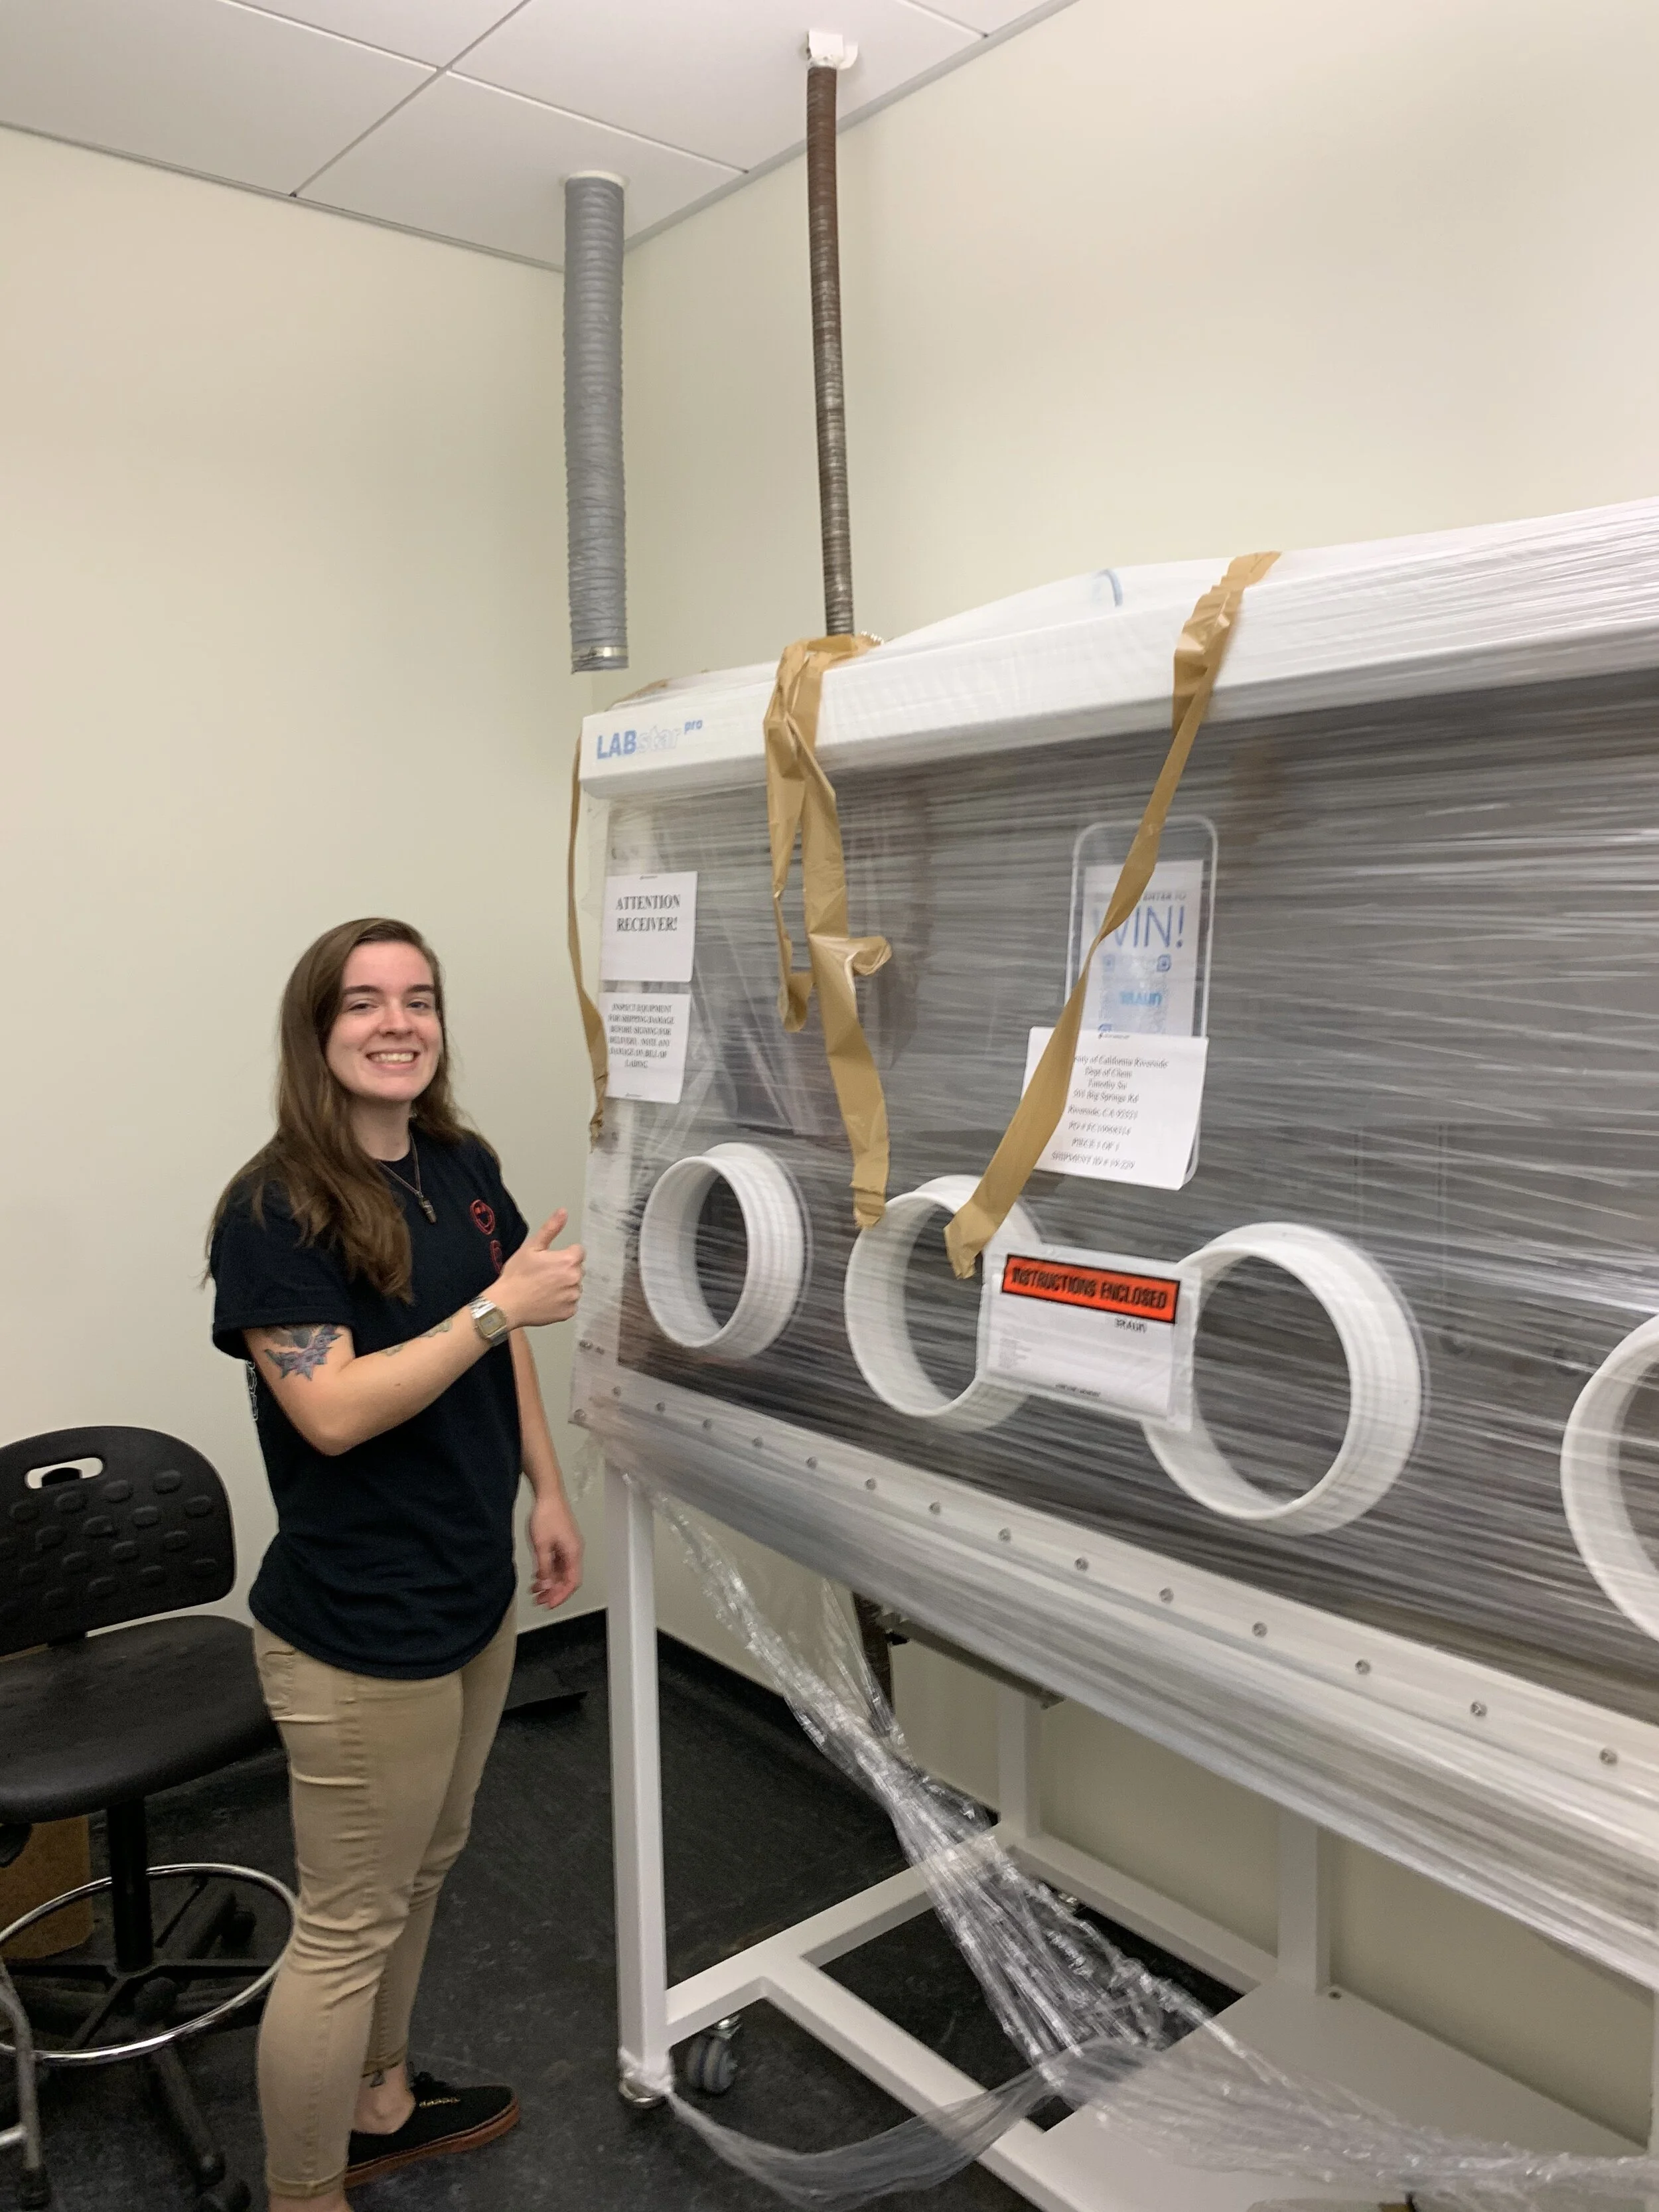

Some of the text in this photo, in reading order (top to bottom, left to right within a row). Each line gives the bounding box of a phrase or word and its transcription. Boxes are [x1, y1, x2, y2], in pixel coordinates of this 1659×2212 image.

[597, 719, 703, 759] LABstar pro
[615, 894, 681, 911] ATTENTION
[616, 917, 678, 932] RECEIVER!
[637, 1003, 673, 1013] EQUIPMENT
[608, 1014, 675, 1025] FOR SHIPPING DAMAGE
[1090, 1055, 1098, 1064] of
[1098, 1055, 1132, 1067] California
[1133, 1057, 1169, 1069] Riverside
[1085, 1067, 1133, 1078] Dept of Chem
[1088, 1078, 1116, 1090] Timothy
[1086, 1089, 1100, 1102] Big
[1100, 1091, 1127, 1104] Springs
[1127, 1092, 1139, 1104] Rd
[1102, 1107, 1115, 1118] CA
[1068, 1120, 1080, 1131] PO
[1071, 1136, 1096, 1149] PIECE
[1102, 1141, 1115, 1151] OF
[1051, 1149, 1092, 1165] SHIPMENT
[1092, 1155, 1104, 1166] ID
[1012, 1267, 1167, 1309] INSTRUCTIONS ENCLOSED
